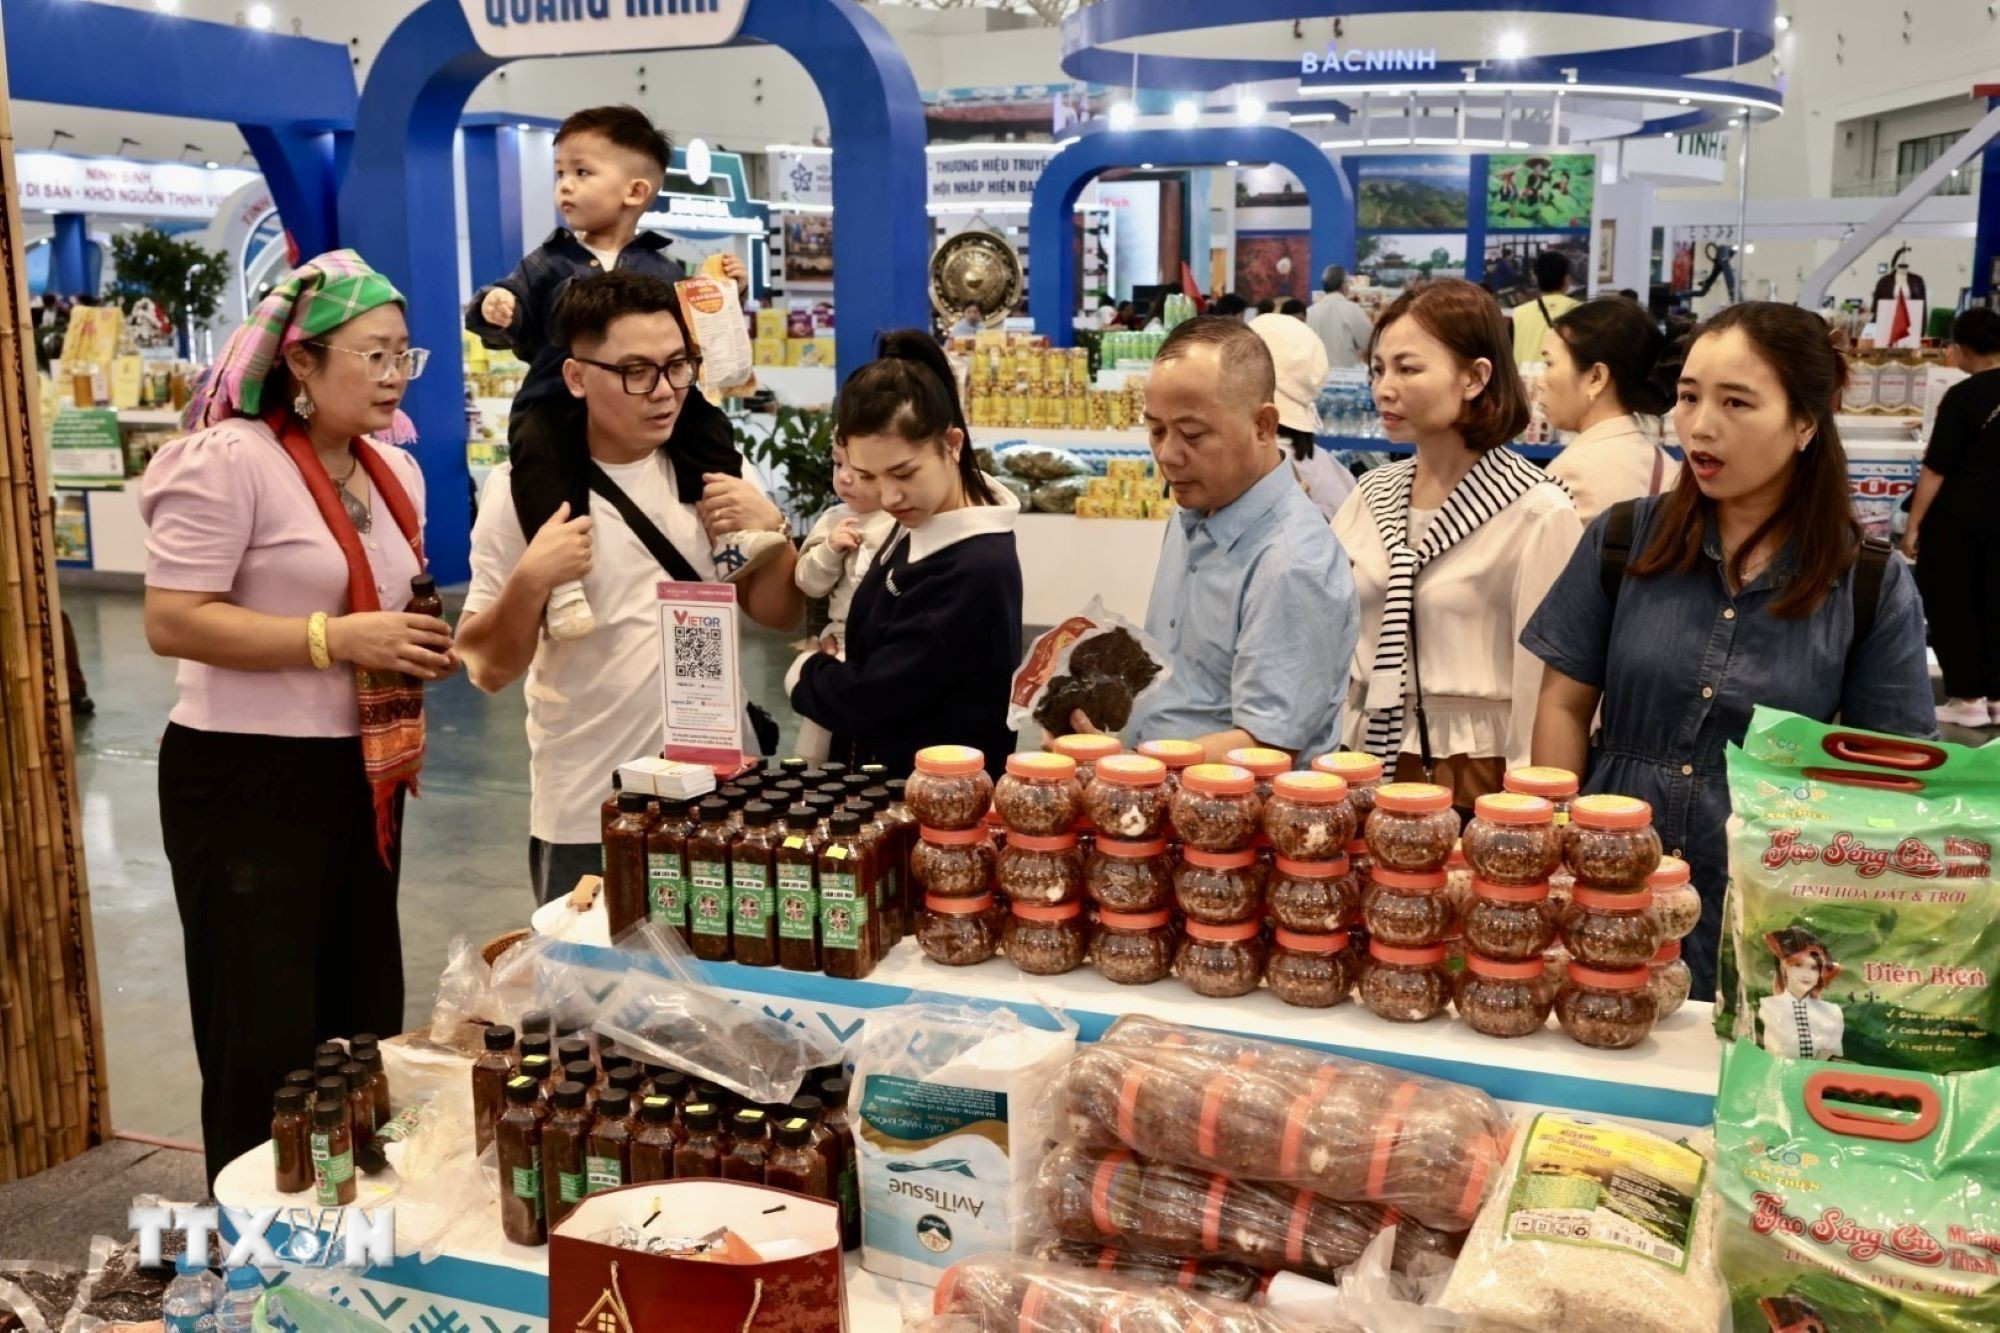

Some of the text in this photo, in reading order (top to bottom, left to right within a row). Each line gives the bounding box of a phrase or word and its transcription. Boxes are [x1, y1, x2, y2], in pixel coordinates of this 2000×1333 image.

[1834, 886, 1868, 900] HOA
[1911, 890, 1924, 902] &
[888, 1178, 984, 1219] AviTissue
